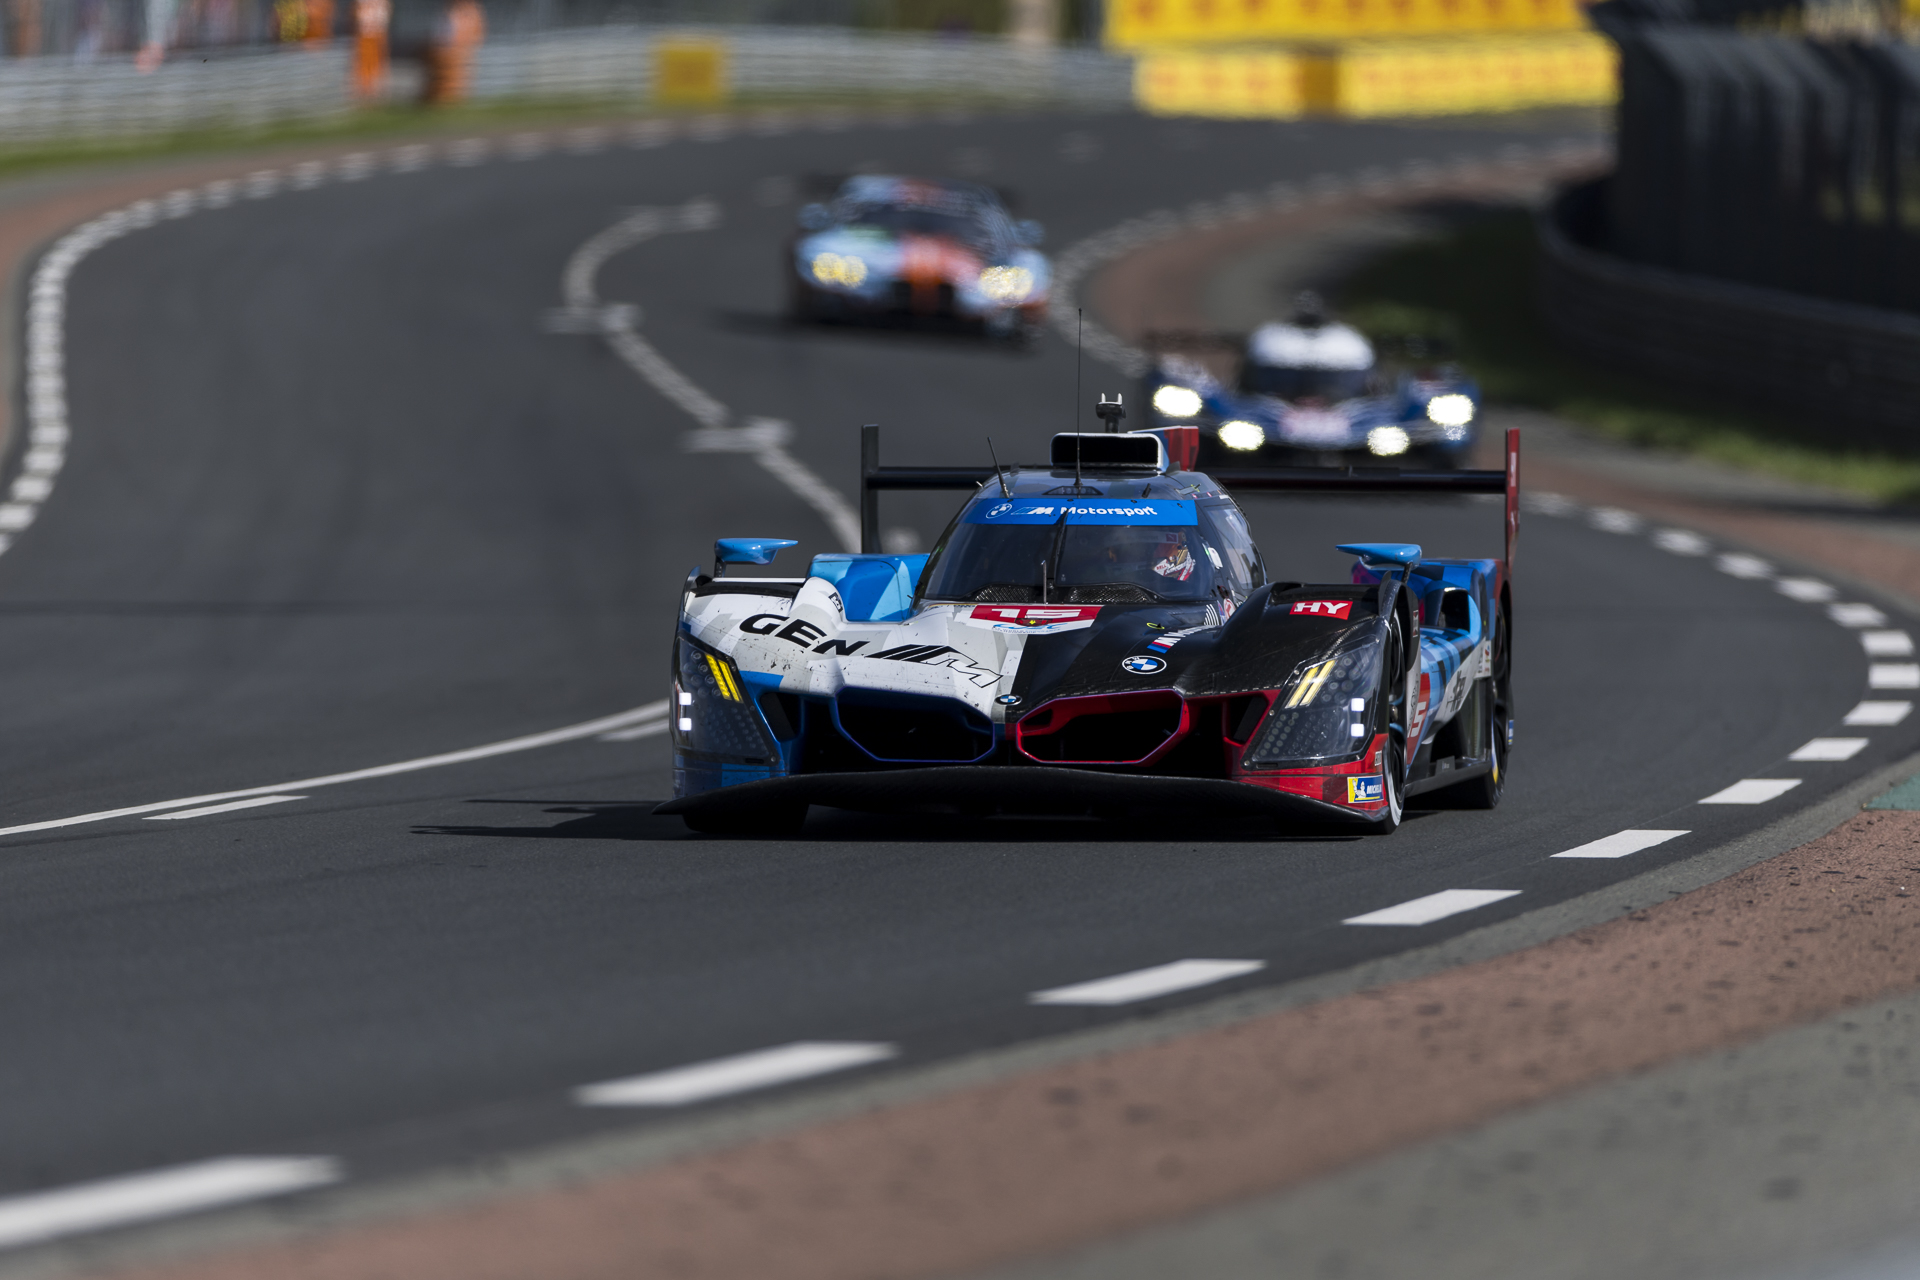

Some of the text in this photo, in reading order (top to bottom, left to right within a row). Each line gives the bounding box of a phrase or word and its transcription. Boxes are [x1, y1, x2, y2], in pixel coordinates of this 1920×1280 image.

[1060, 506, 1157, 517] Motorsport
[991, 608, 1082, 620] 15
[1293, 602, 1349, 615] HY
[739, 613, 871, 656] GEN
